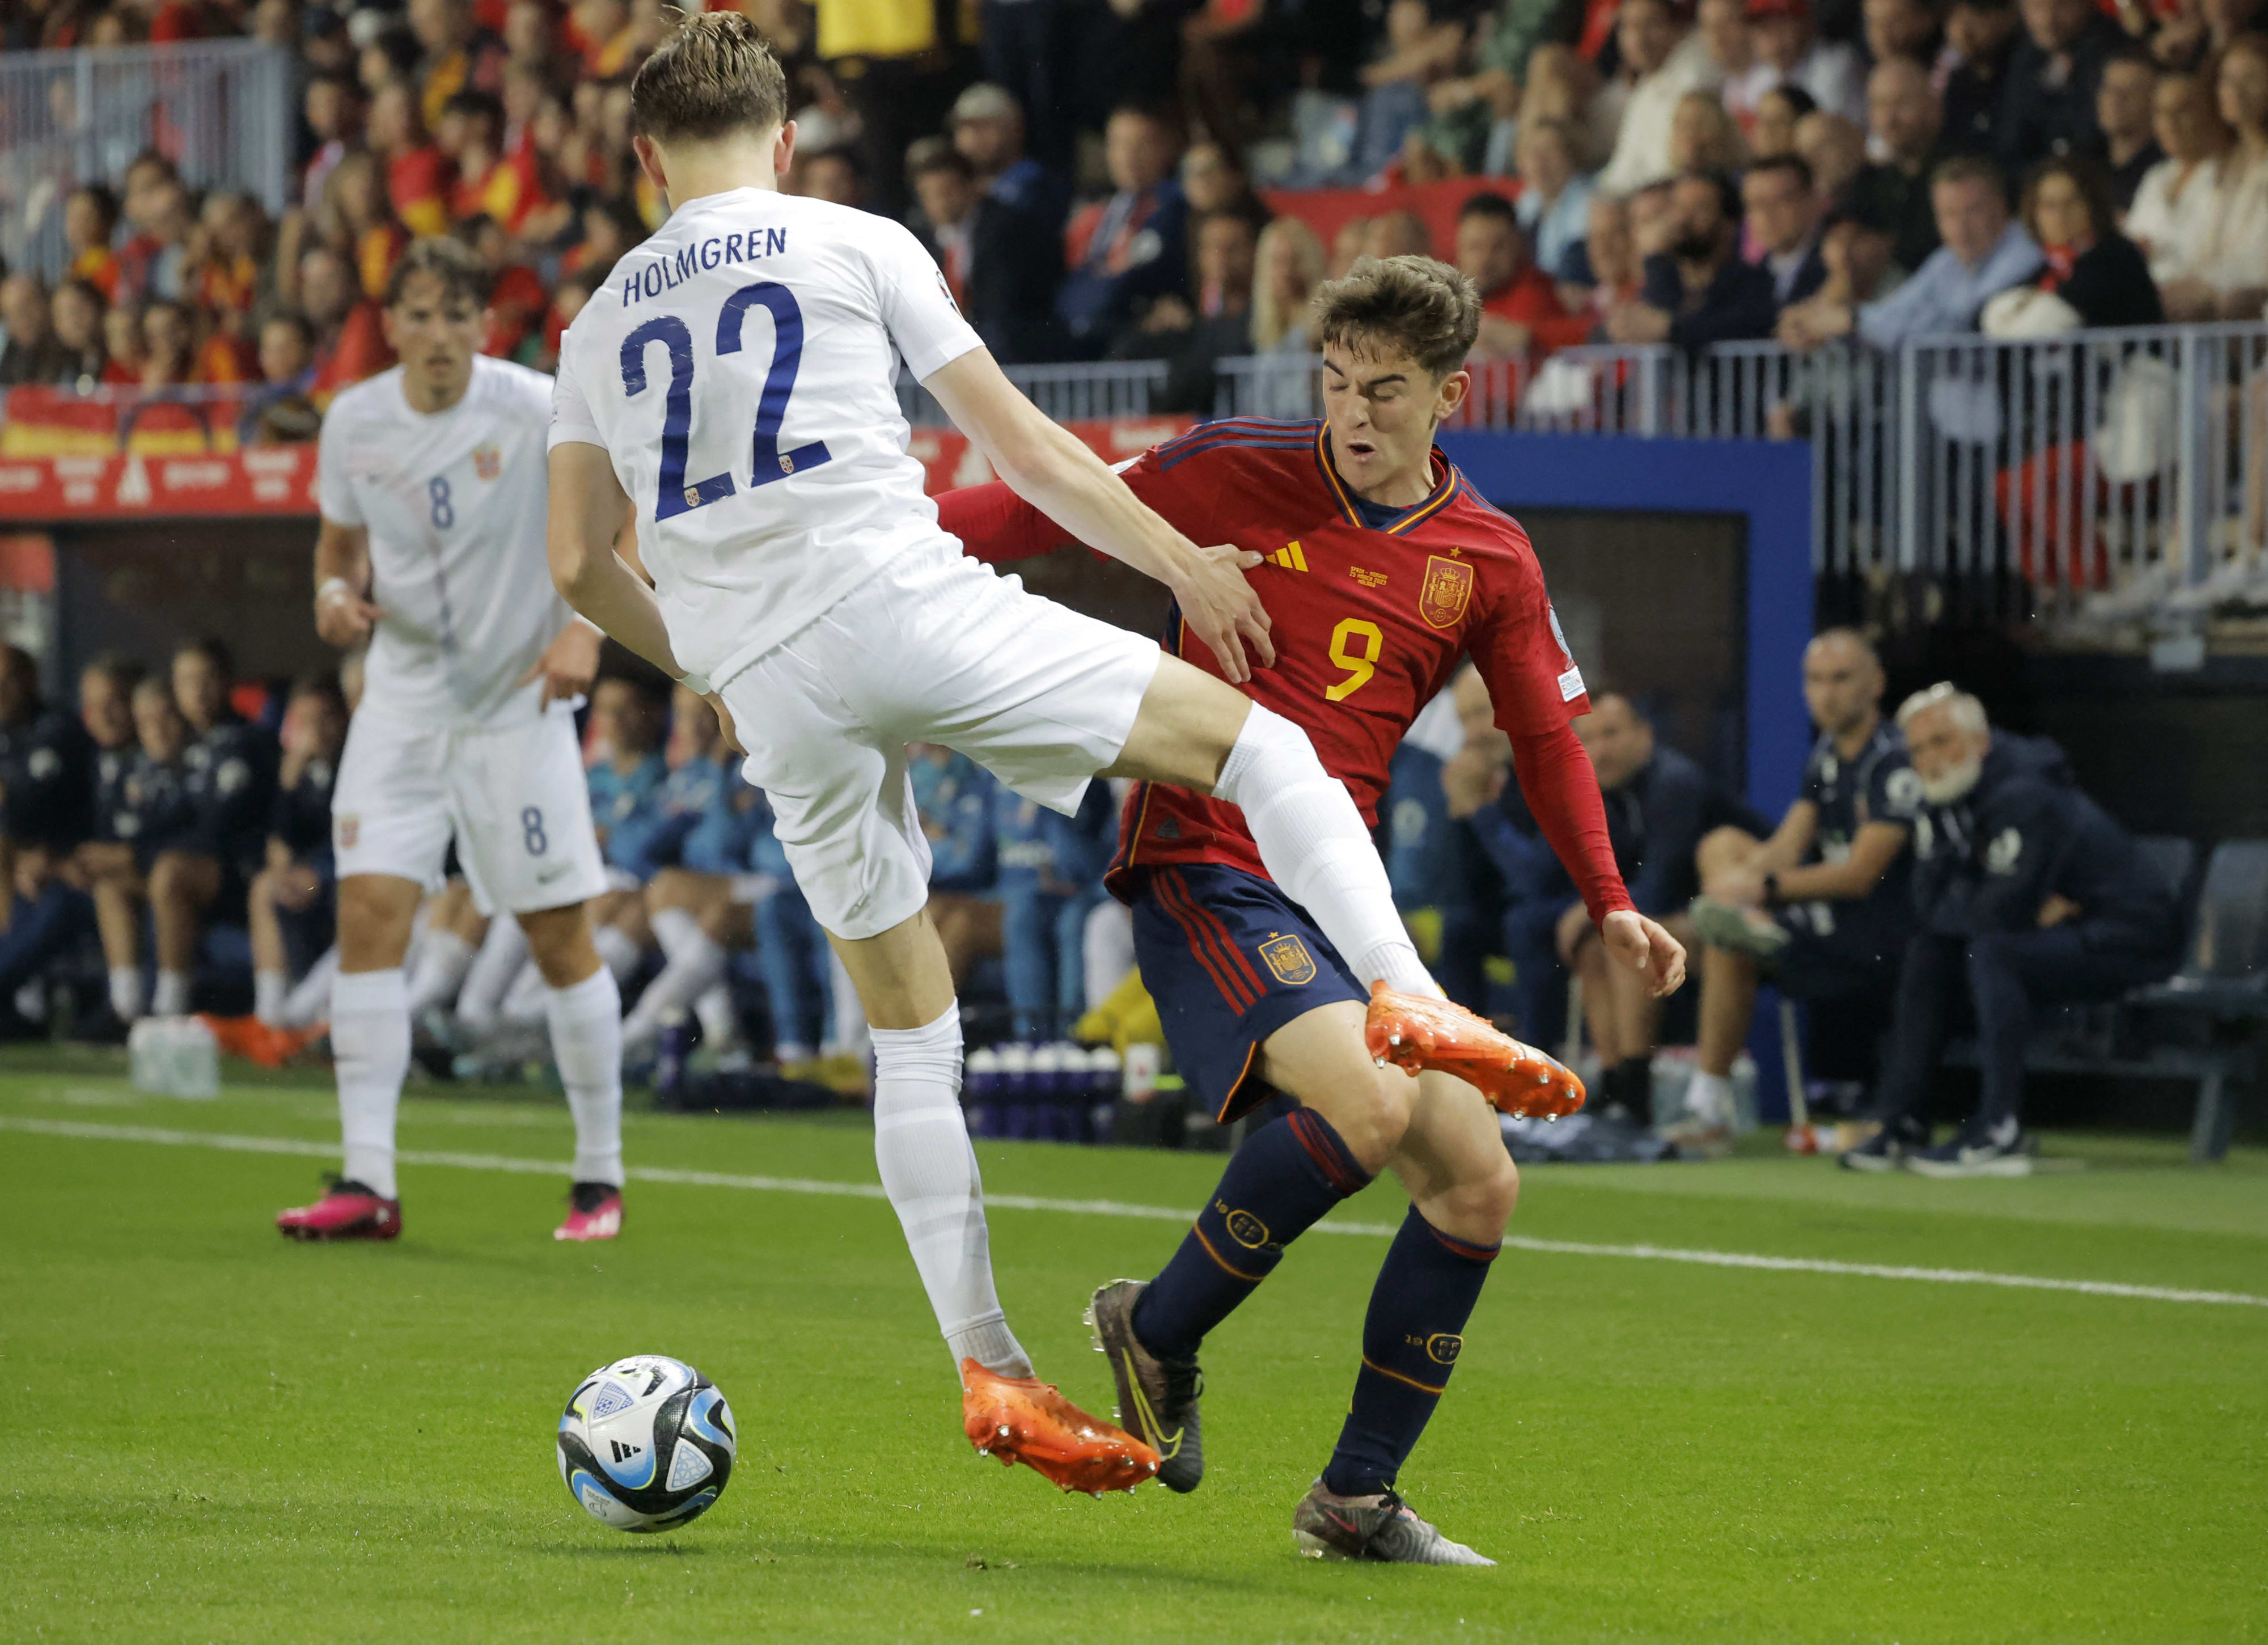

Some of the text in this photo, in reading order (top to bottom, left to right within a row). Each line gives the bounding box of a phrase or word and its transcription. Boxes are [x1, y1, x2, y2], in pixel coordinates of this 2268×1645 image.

[623, 227, 786, 307] HOLMGREN
[620, 281, 832, 523] 22
[429, 476, 454, 528] 8
[1325, 618, 1383, 701] 9
[522, 806, 547, 856] 8
